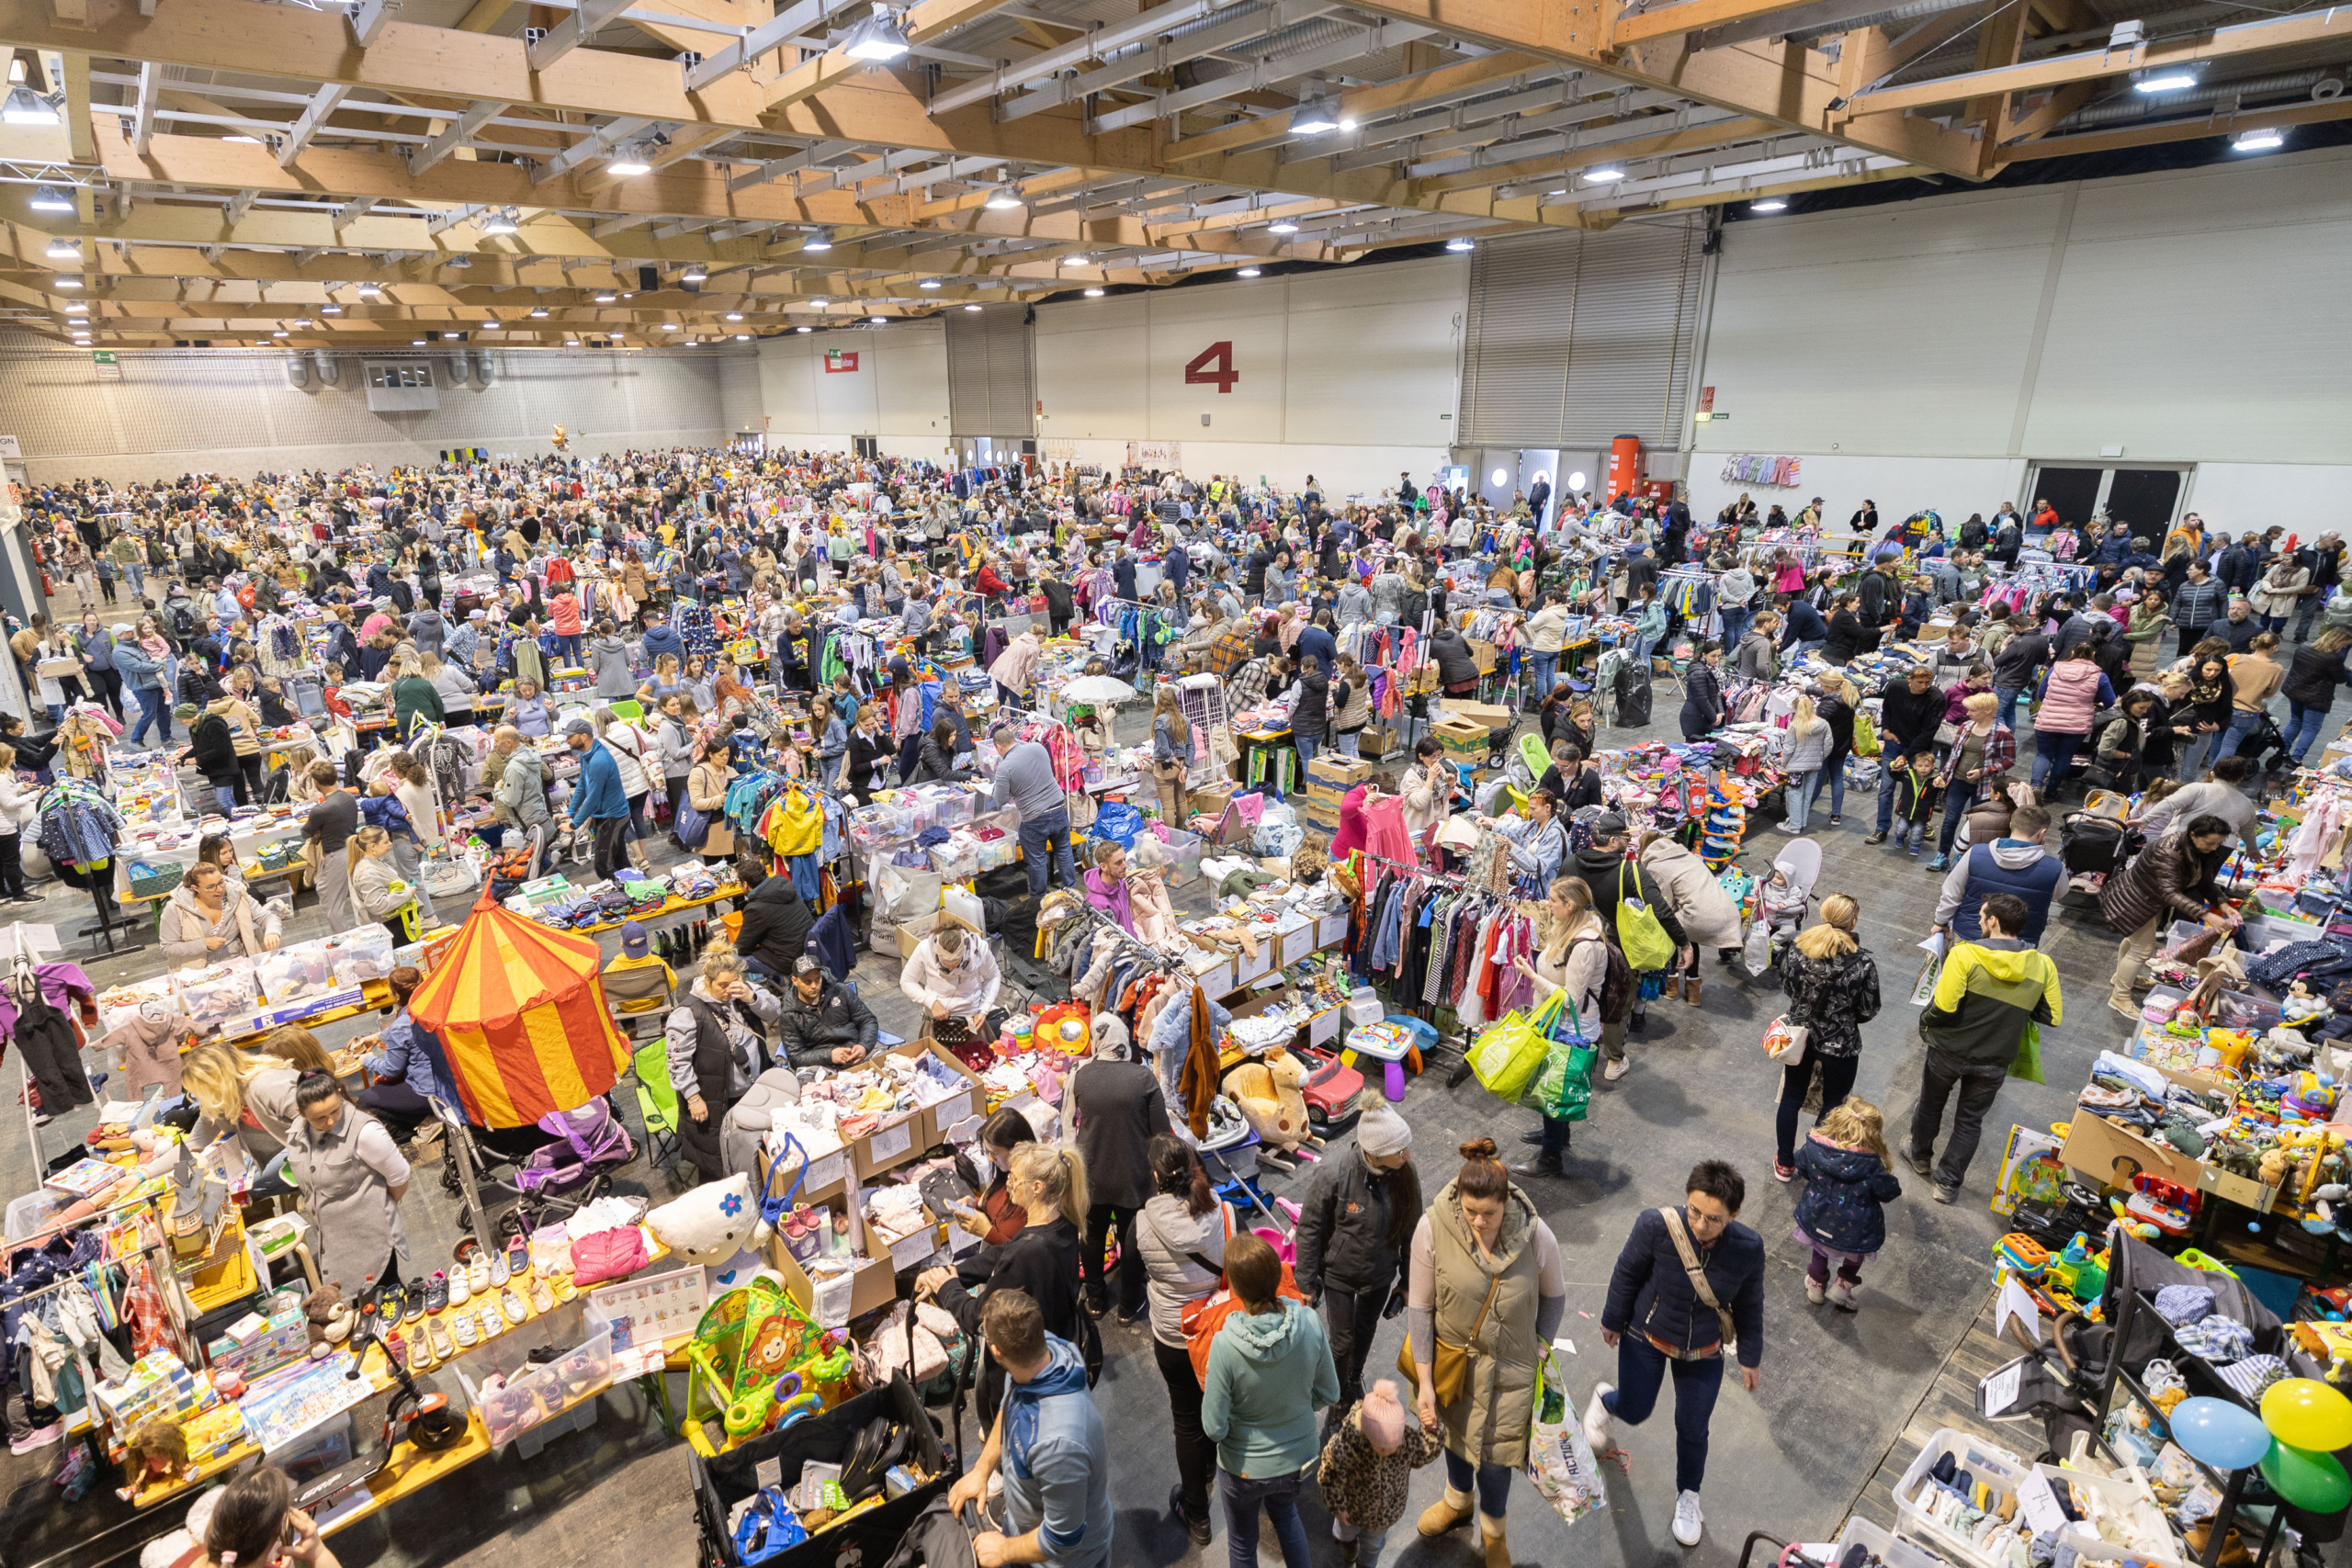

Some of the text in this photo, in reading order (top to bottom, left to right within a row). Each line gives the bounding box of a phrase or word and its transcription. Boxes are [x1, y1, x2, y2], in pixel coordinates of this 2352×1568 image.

[1185, 341, 1239, 393] 4
[1314, 787, 1336, 797] BANANAS
[876, 1132, 909, 1152] 50-68
[1559, 1438, 1579, 1475] ACTION
[300, 1472, 343, 1502] GRIP
[2032, 1483, 2049, 1514] 74
